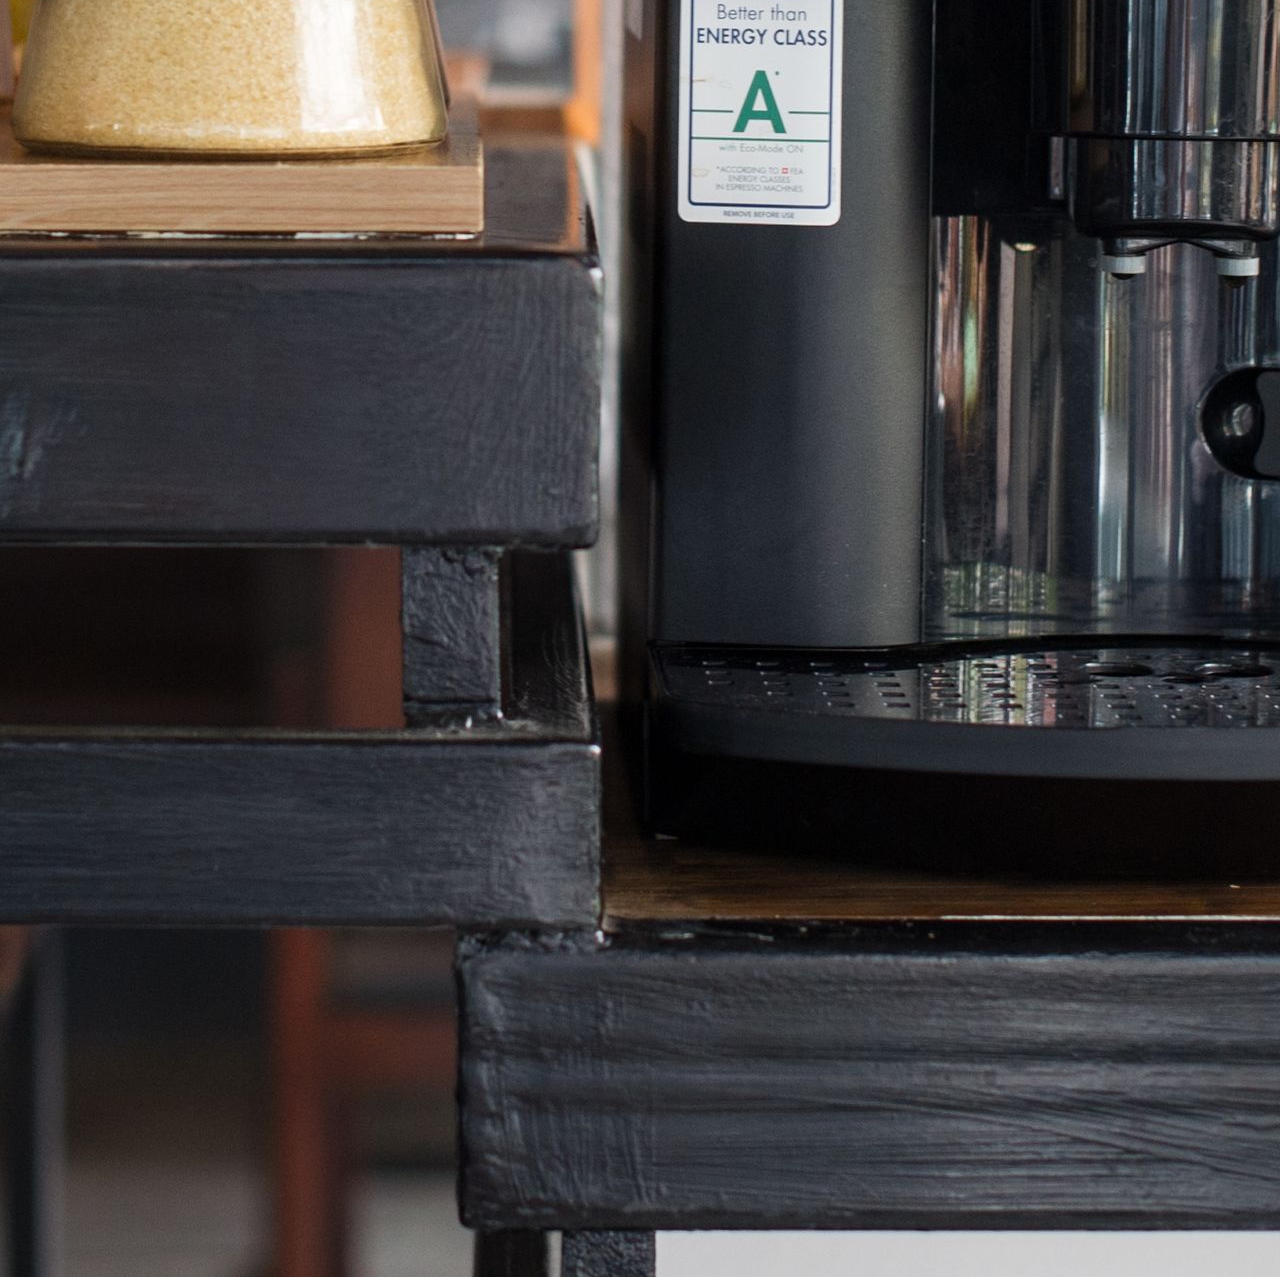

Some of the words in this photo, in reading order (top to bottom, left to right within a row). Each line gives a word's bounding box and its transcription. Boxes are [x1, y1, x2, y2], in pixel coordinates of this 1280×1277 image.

[717, 3, 764, 21] Better
[771, 3, 807, 22] than
[697, 27, 767, 45] ENERGY
[773, 29, 827, 46] CLASS
[786, 144, 804, 153] ON
[726, 183, 761, 192] ESPRESSO
[763, 185, 804, 193] MACHINES
[723, 210, 752, 218] REMOVE
[781, 211, 795, 219] USE
